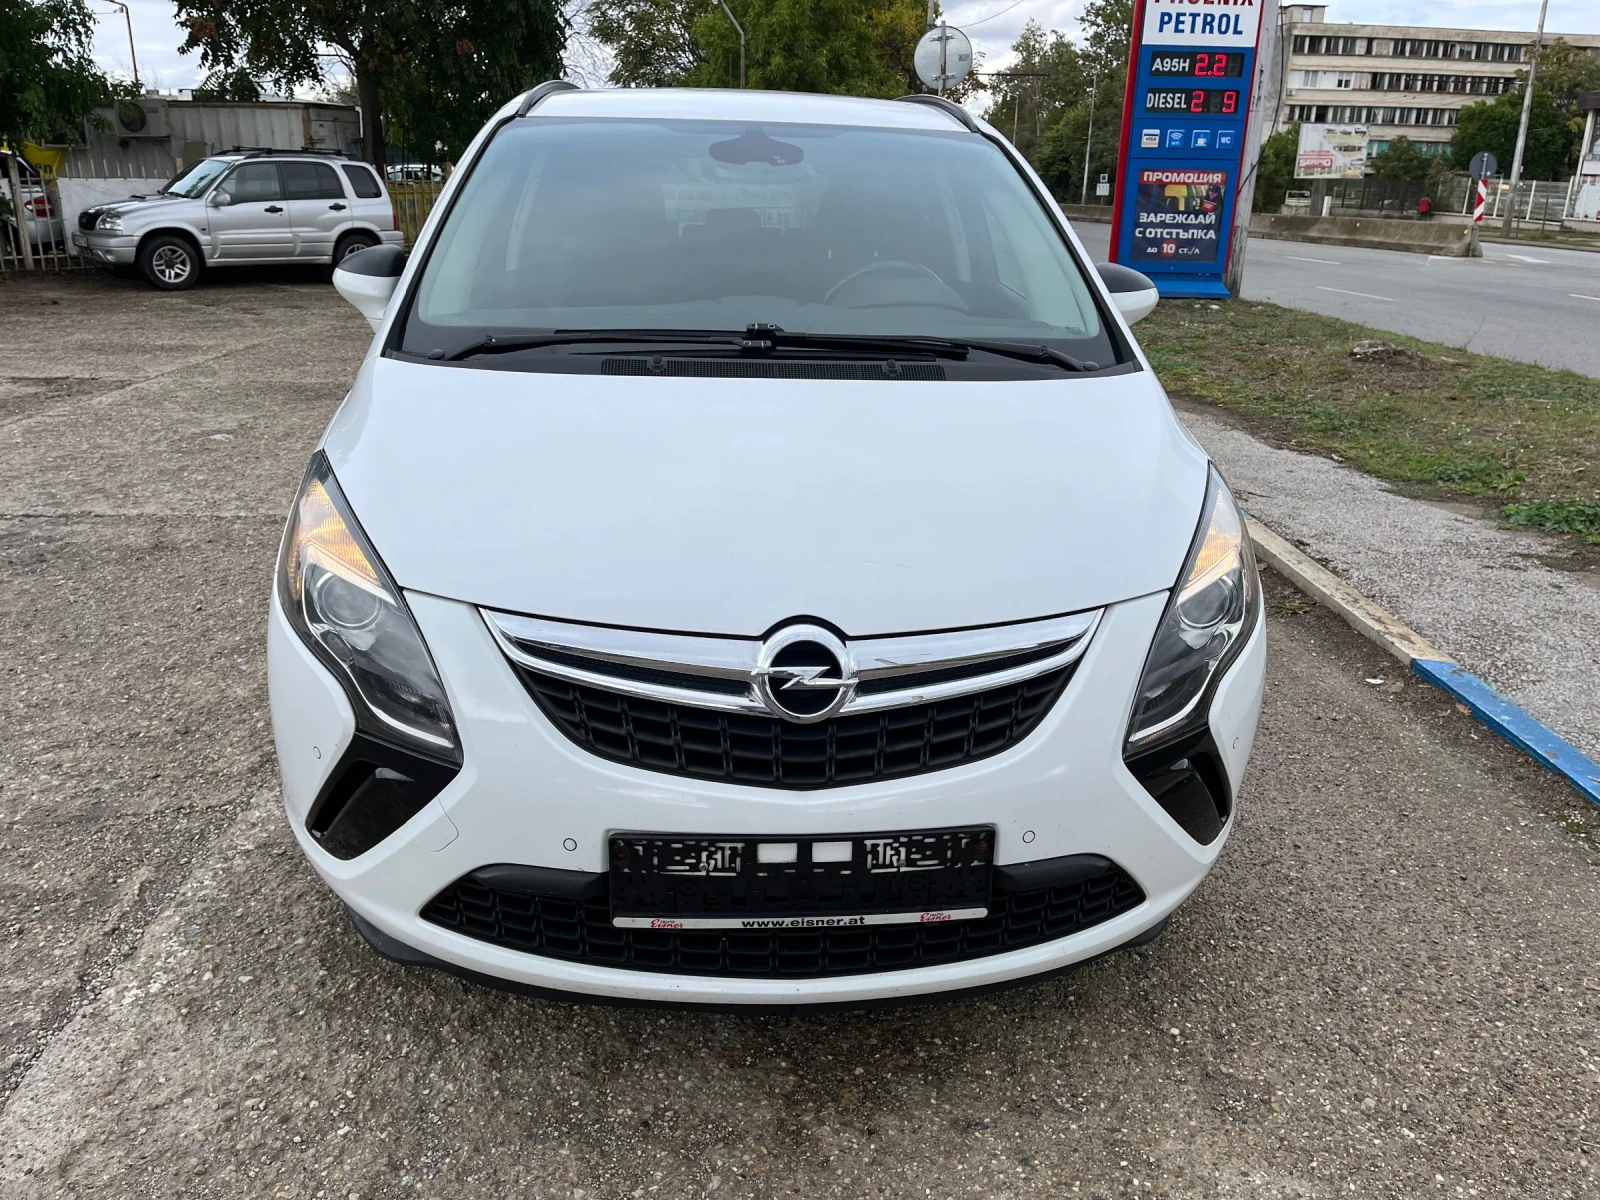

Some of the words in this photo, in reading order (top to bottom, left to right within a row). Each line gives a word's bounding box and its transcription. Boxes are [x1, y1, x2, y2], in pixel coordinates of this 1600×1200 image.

[1158, 12, 1243, 35] PETROL
[1151, 58, 1190, 72] A95H
[1194, 53, 1227, 76] 2.2
[1146, 93, 1187, 109] DIESEL
[1220, 136, 1232, 144] WC
[1143, 171, 1222, 183] ПРОМОЦИЯ
[1139, 212, 1216, 224] ЗАРЕЖДАЙ
[1135, 227, 1144, 238] С
[1145, 228, 1216, 240] ОТСТЪПКА
[1162, 243, 1176, 254] 10
[741, 916, 865, 928] www.eisner.at
